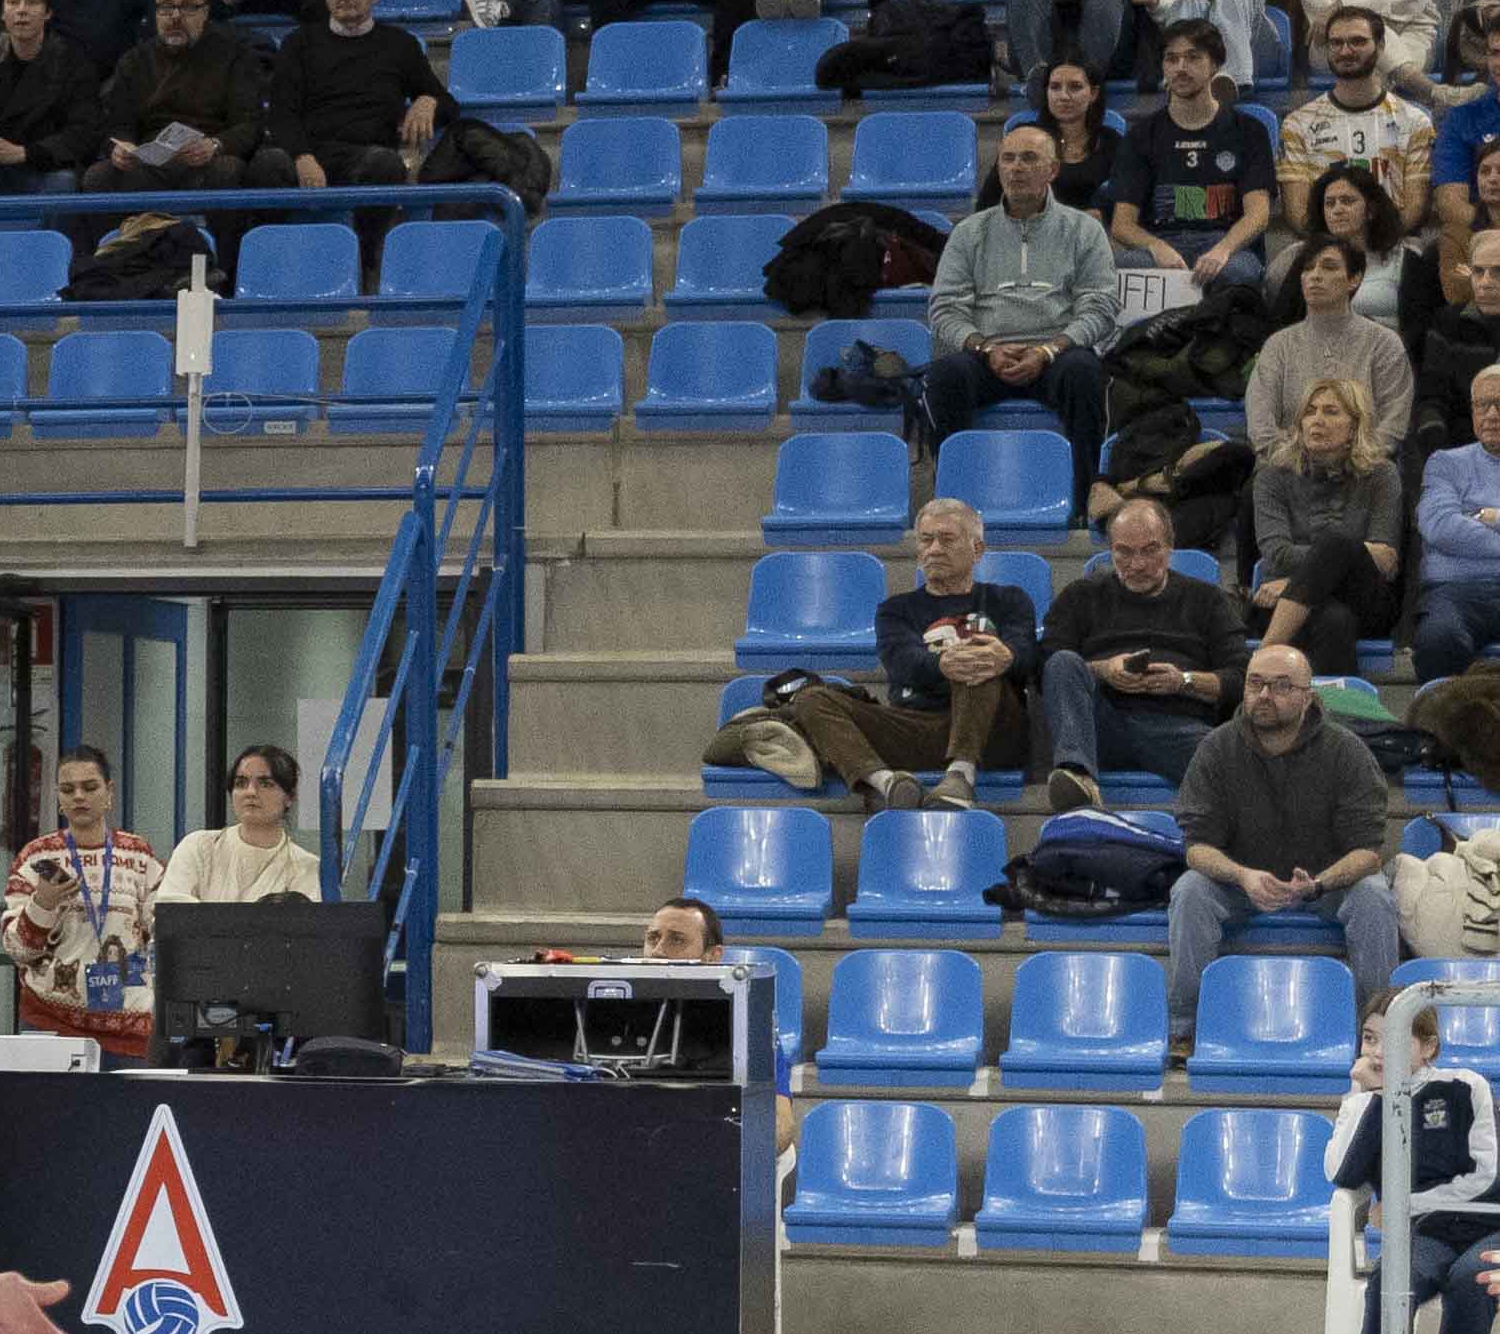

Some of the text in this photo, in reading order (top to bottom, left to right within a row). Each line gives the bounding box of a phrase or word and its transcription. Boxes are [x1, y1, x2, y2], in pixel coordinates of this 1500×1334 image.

[1351, 130, 1366, 155] 3
[1185, 151, 1199, 167] 3
[88, 975, 120, 988] STAFF
